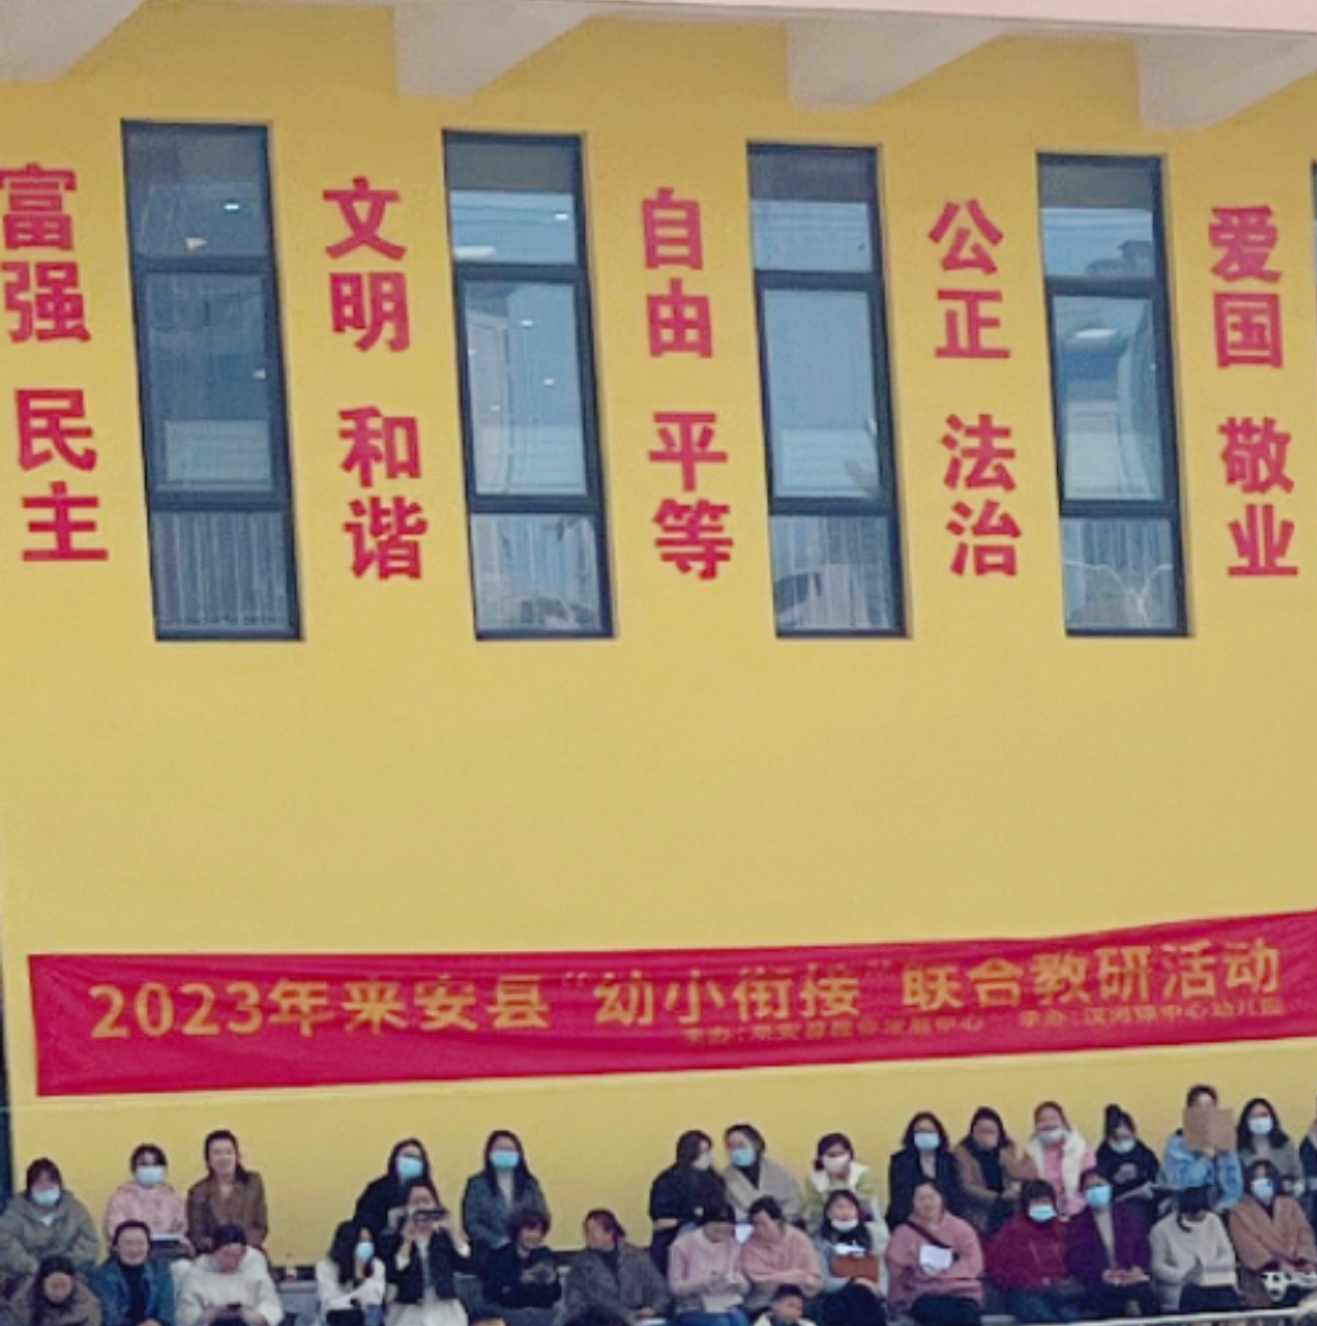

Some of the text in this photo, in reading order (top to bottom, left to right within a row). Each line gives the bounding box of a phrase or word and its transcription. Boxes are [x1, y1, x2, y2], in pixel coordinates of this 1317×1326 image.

[0, 163, 109, 562] 富强 民主
[323, 176, 428, 580] 文明 和谐
[642, 187, 733, 580] 自由 平等
[928, 199, 1021, 577] 公正 法治
[1208, 205, 1298, 577] 爱国 敬业
